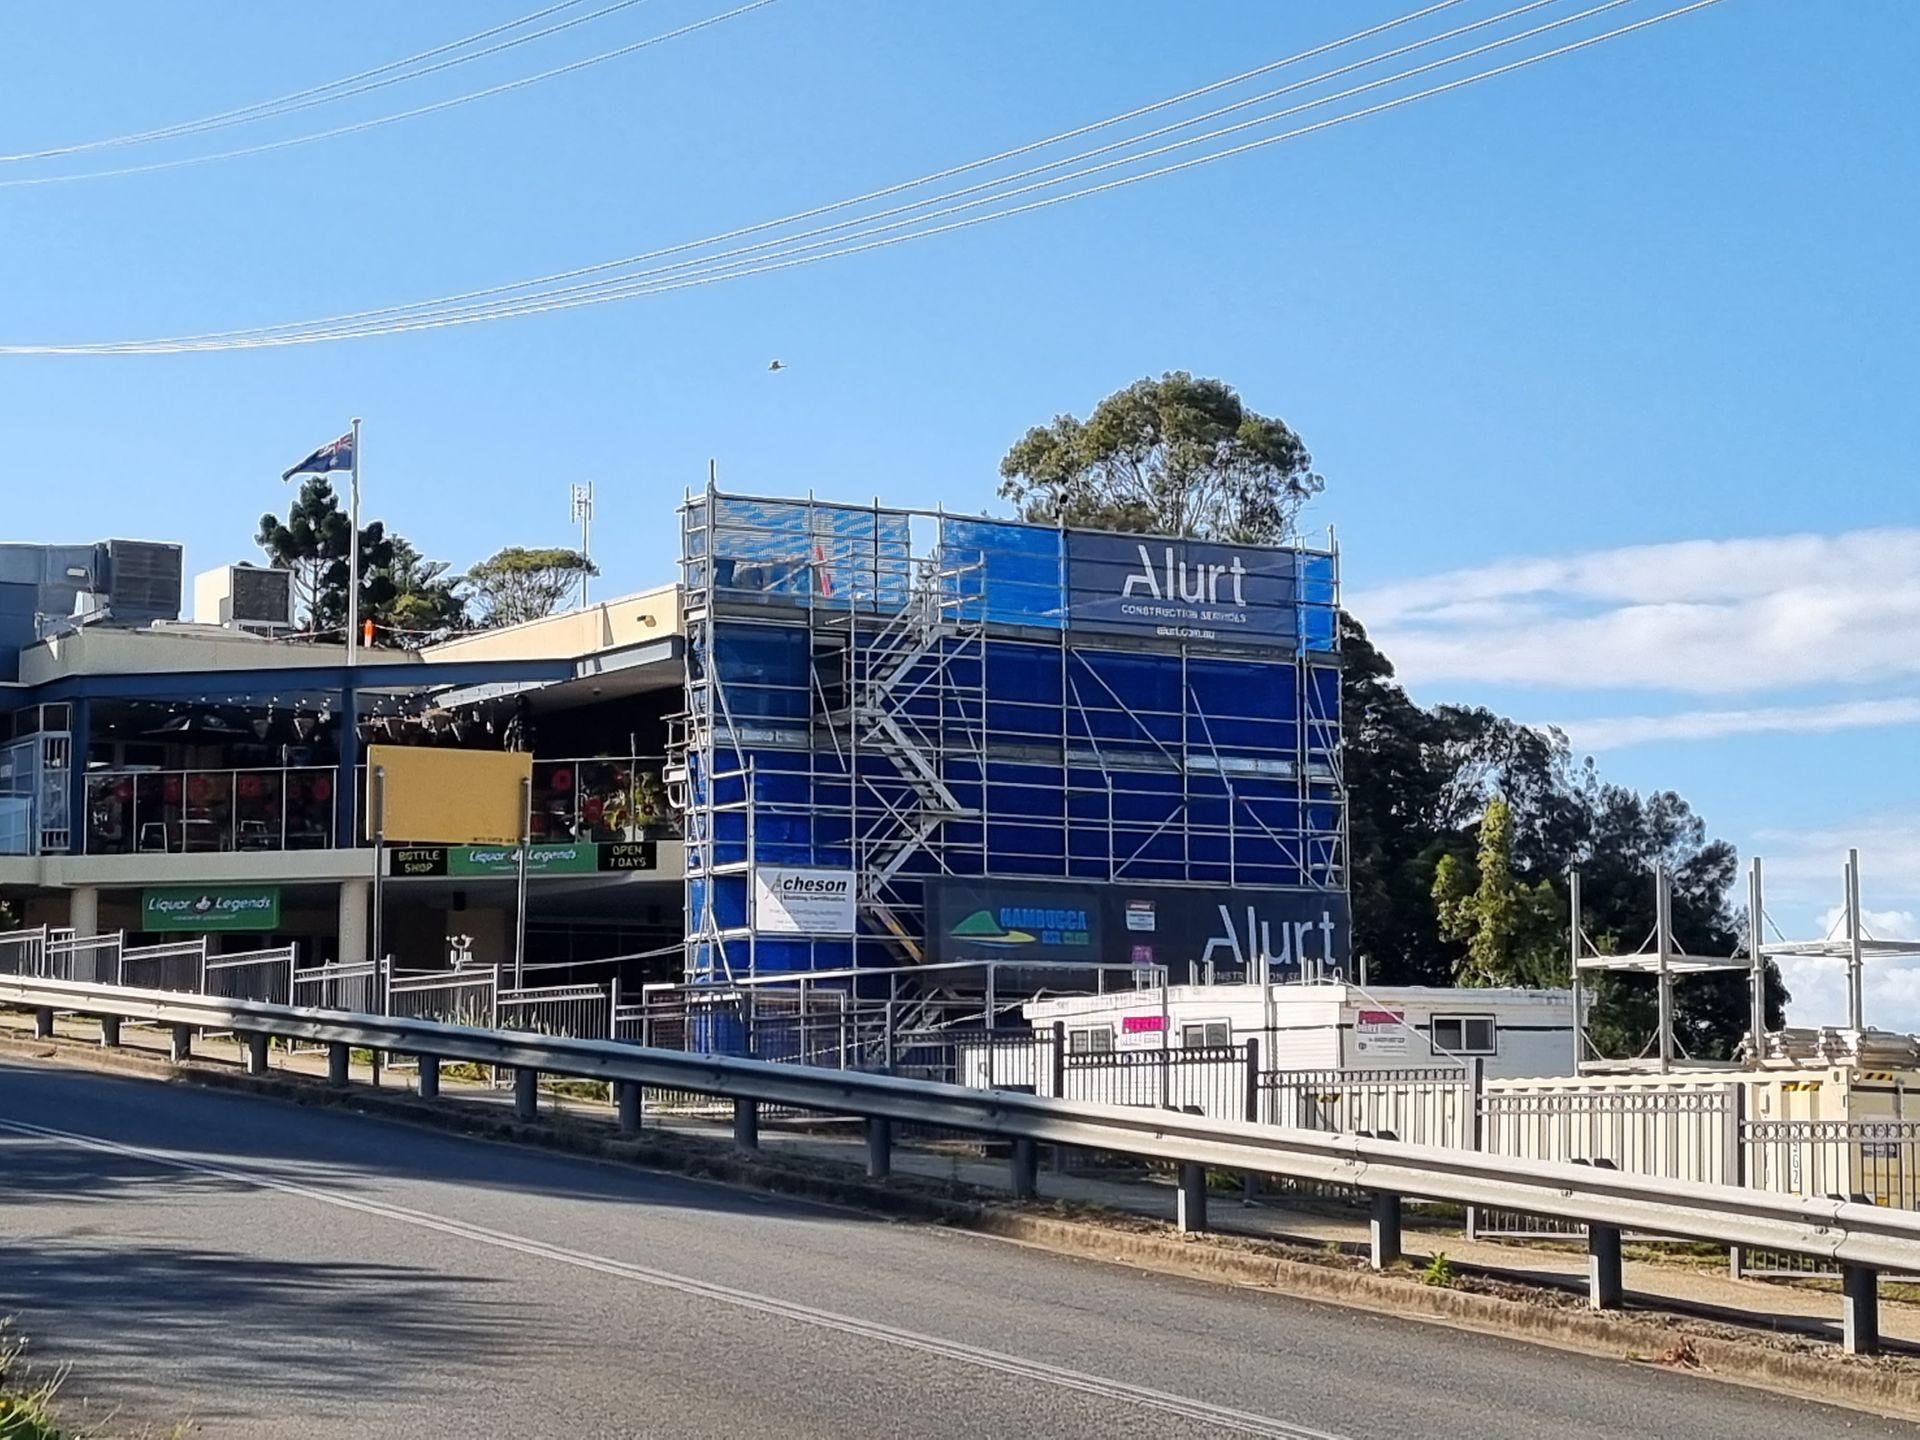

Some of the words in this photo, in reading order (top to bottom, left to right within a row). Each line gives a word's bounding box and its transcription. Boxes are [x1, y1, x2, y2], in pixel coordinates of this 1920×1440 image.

[1122, 545, 1248, 608] Alurt
[1121, 604, 1198, 620] CONSTRUCTION
[1200, 610, 1248, 624] SERVICES
[399, 850, 440, 861] BOTTLE
[469, 850, 508, 864] Liquor
[527, 848, 577, 862] Legends
[612, 845, 642, 856] OPEN
[404, 863, 434, 873] SHOP
[617, 857, 647, 868] DAYS
[147, 897, 191, 913] Liquor
[215, 896, 271, 912] Legends
[1000, 907, 1088, 930] NAMBUCCA
[1201, 904, 1337, 966] Alurt
